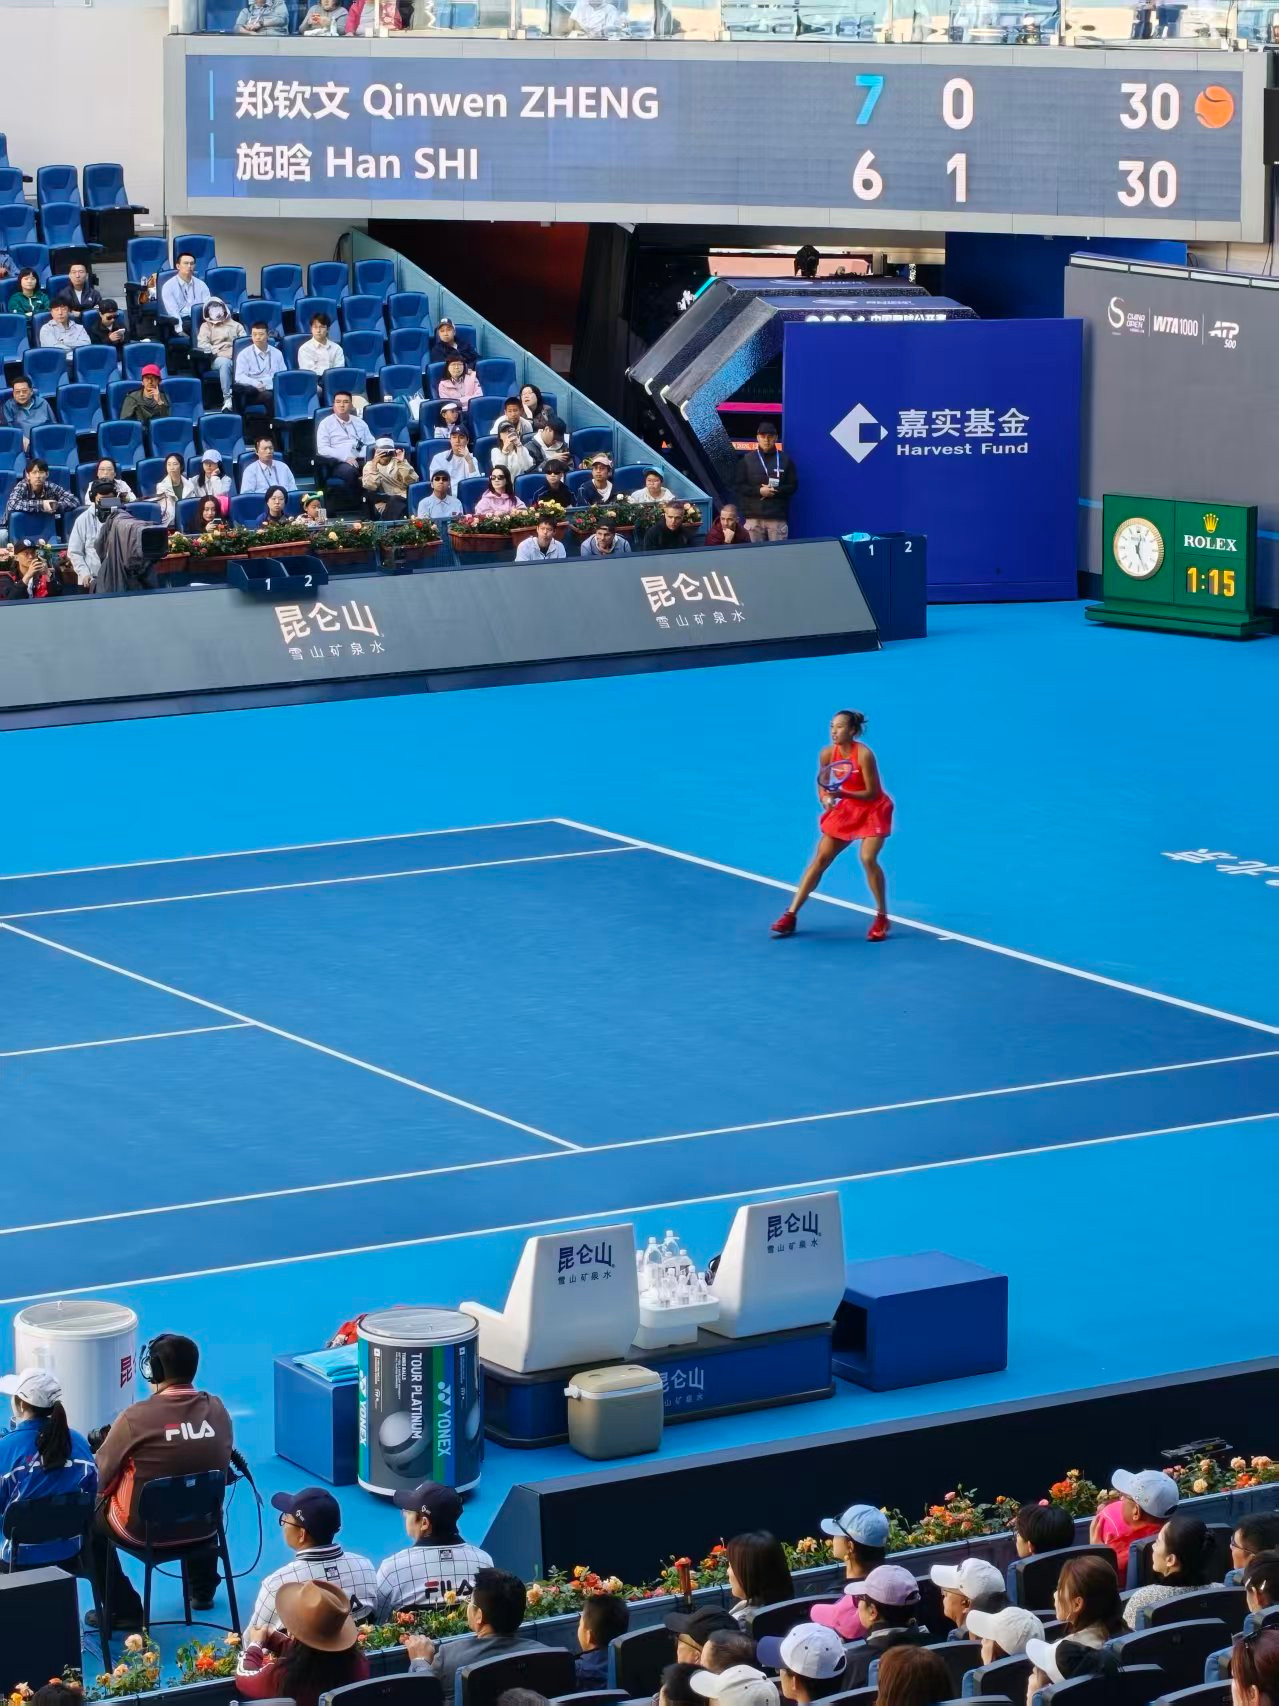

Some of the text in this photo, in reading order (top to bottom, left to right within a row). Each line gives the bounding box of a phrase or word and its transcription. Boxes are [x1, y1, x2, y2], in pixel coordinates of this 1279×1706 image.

[235, 79, 660, 121] 郑钦文 Qinwen ZHENG
[854, 75, 885, 126] 7
[942, 77, 974, 131] 0
[1119, 82, 1180, 131] 30
[236, 142, 479, 182] 施晗 Han SHI
[852, 149, 883, 201] 6
[946, 152, 967, 203] 1
[1117, 160, 1178, 208] 30
[1208, 321, 1240, 339] ATP
[1224, 339, 1237, 349] 500
[896, 407, 1030, 438] 嘉实基金
[896, 442, 1029, 456] Harvest Fund
[868, 544, 875, 556] 1
[904, 541, 912, 553] 2
[1183, 534, 1238, 552] ROLEX
[265, 578, 271, 591] 1
[304, 575, 312, 587] 2
[640, 571, 741, 613] 昆仑山
[1186, 567, 1236, 598] 1:15
[274, 600, 380, 645] 昆仑山
[655, 609, 747, 629] 雪山矿泉水
[288, 639, 385, 661] 雪山矿泉水
[767, 1210, 818, 1242] 昆仑山
[558, 1241, 612, 1274] 昆仑山
[410, 1352, 423, 1440] TOUR PLATINUM
[164, 1420, 216, 1442] FILA
[359, 1401, 367, 1447] YONEX
[437, 1410, 451, 1457] YONEX
[424, 1578, 474, 1600] FILA
